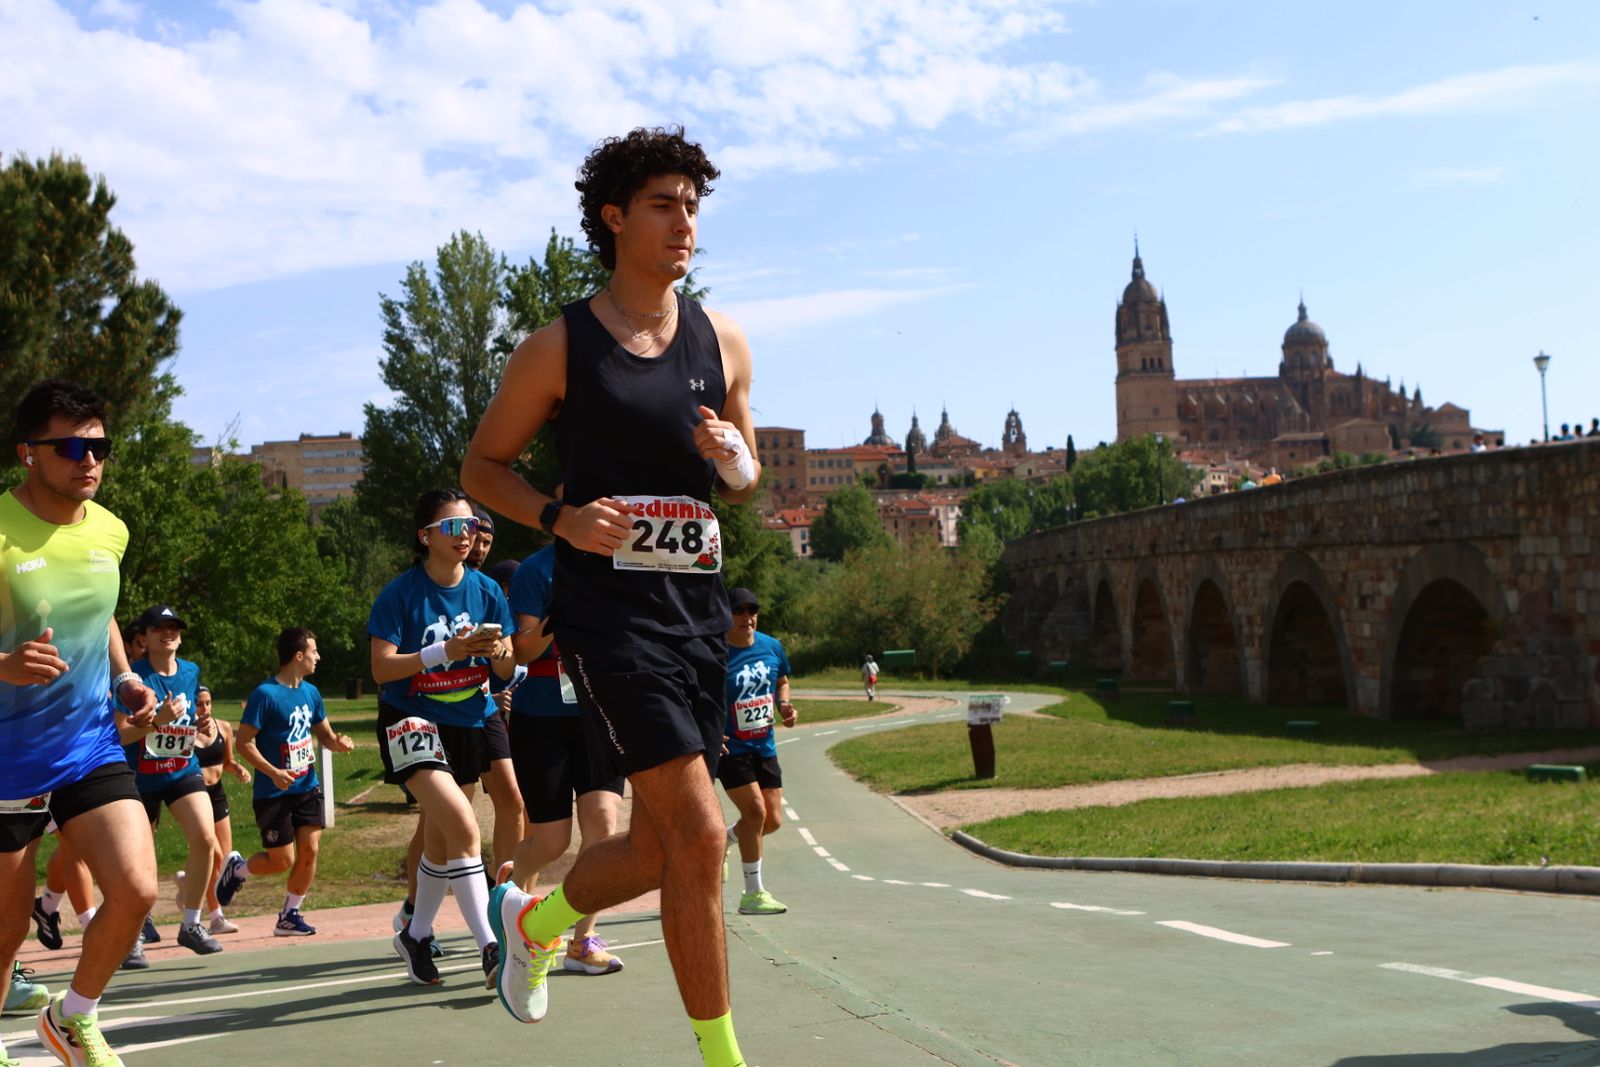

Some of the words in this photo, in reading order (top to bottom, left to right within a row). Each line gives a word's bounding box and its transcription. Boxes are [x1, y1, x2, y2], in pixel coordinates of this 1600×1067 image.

[628, 499, 714, 519] edunia
[631, 520, 703, 554] 248
[15, 557, 48, 574] HOKA
[423, 680, 452, 689] CARRERA
[744, 705, 769, 723] 222
[155, 734, 186, 750] 181
[397, 731, 434, 756] 127
